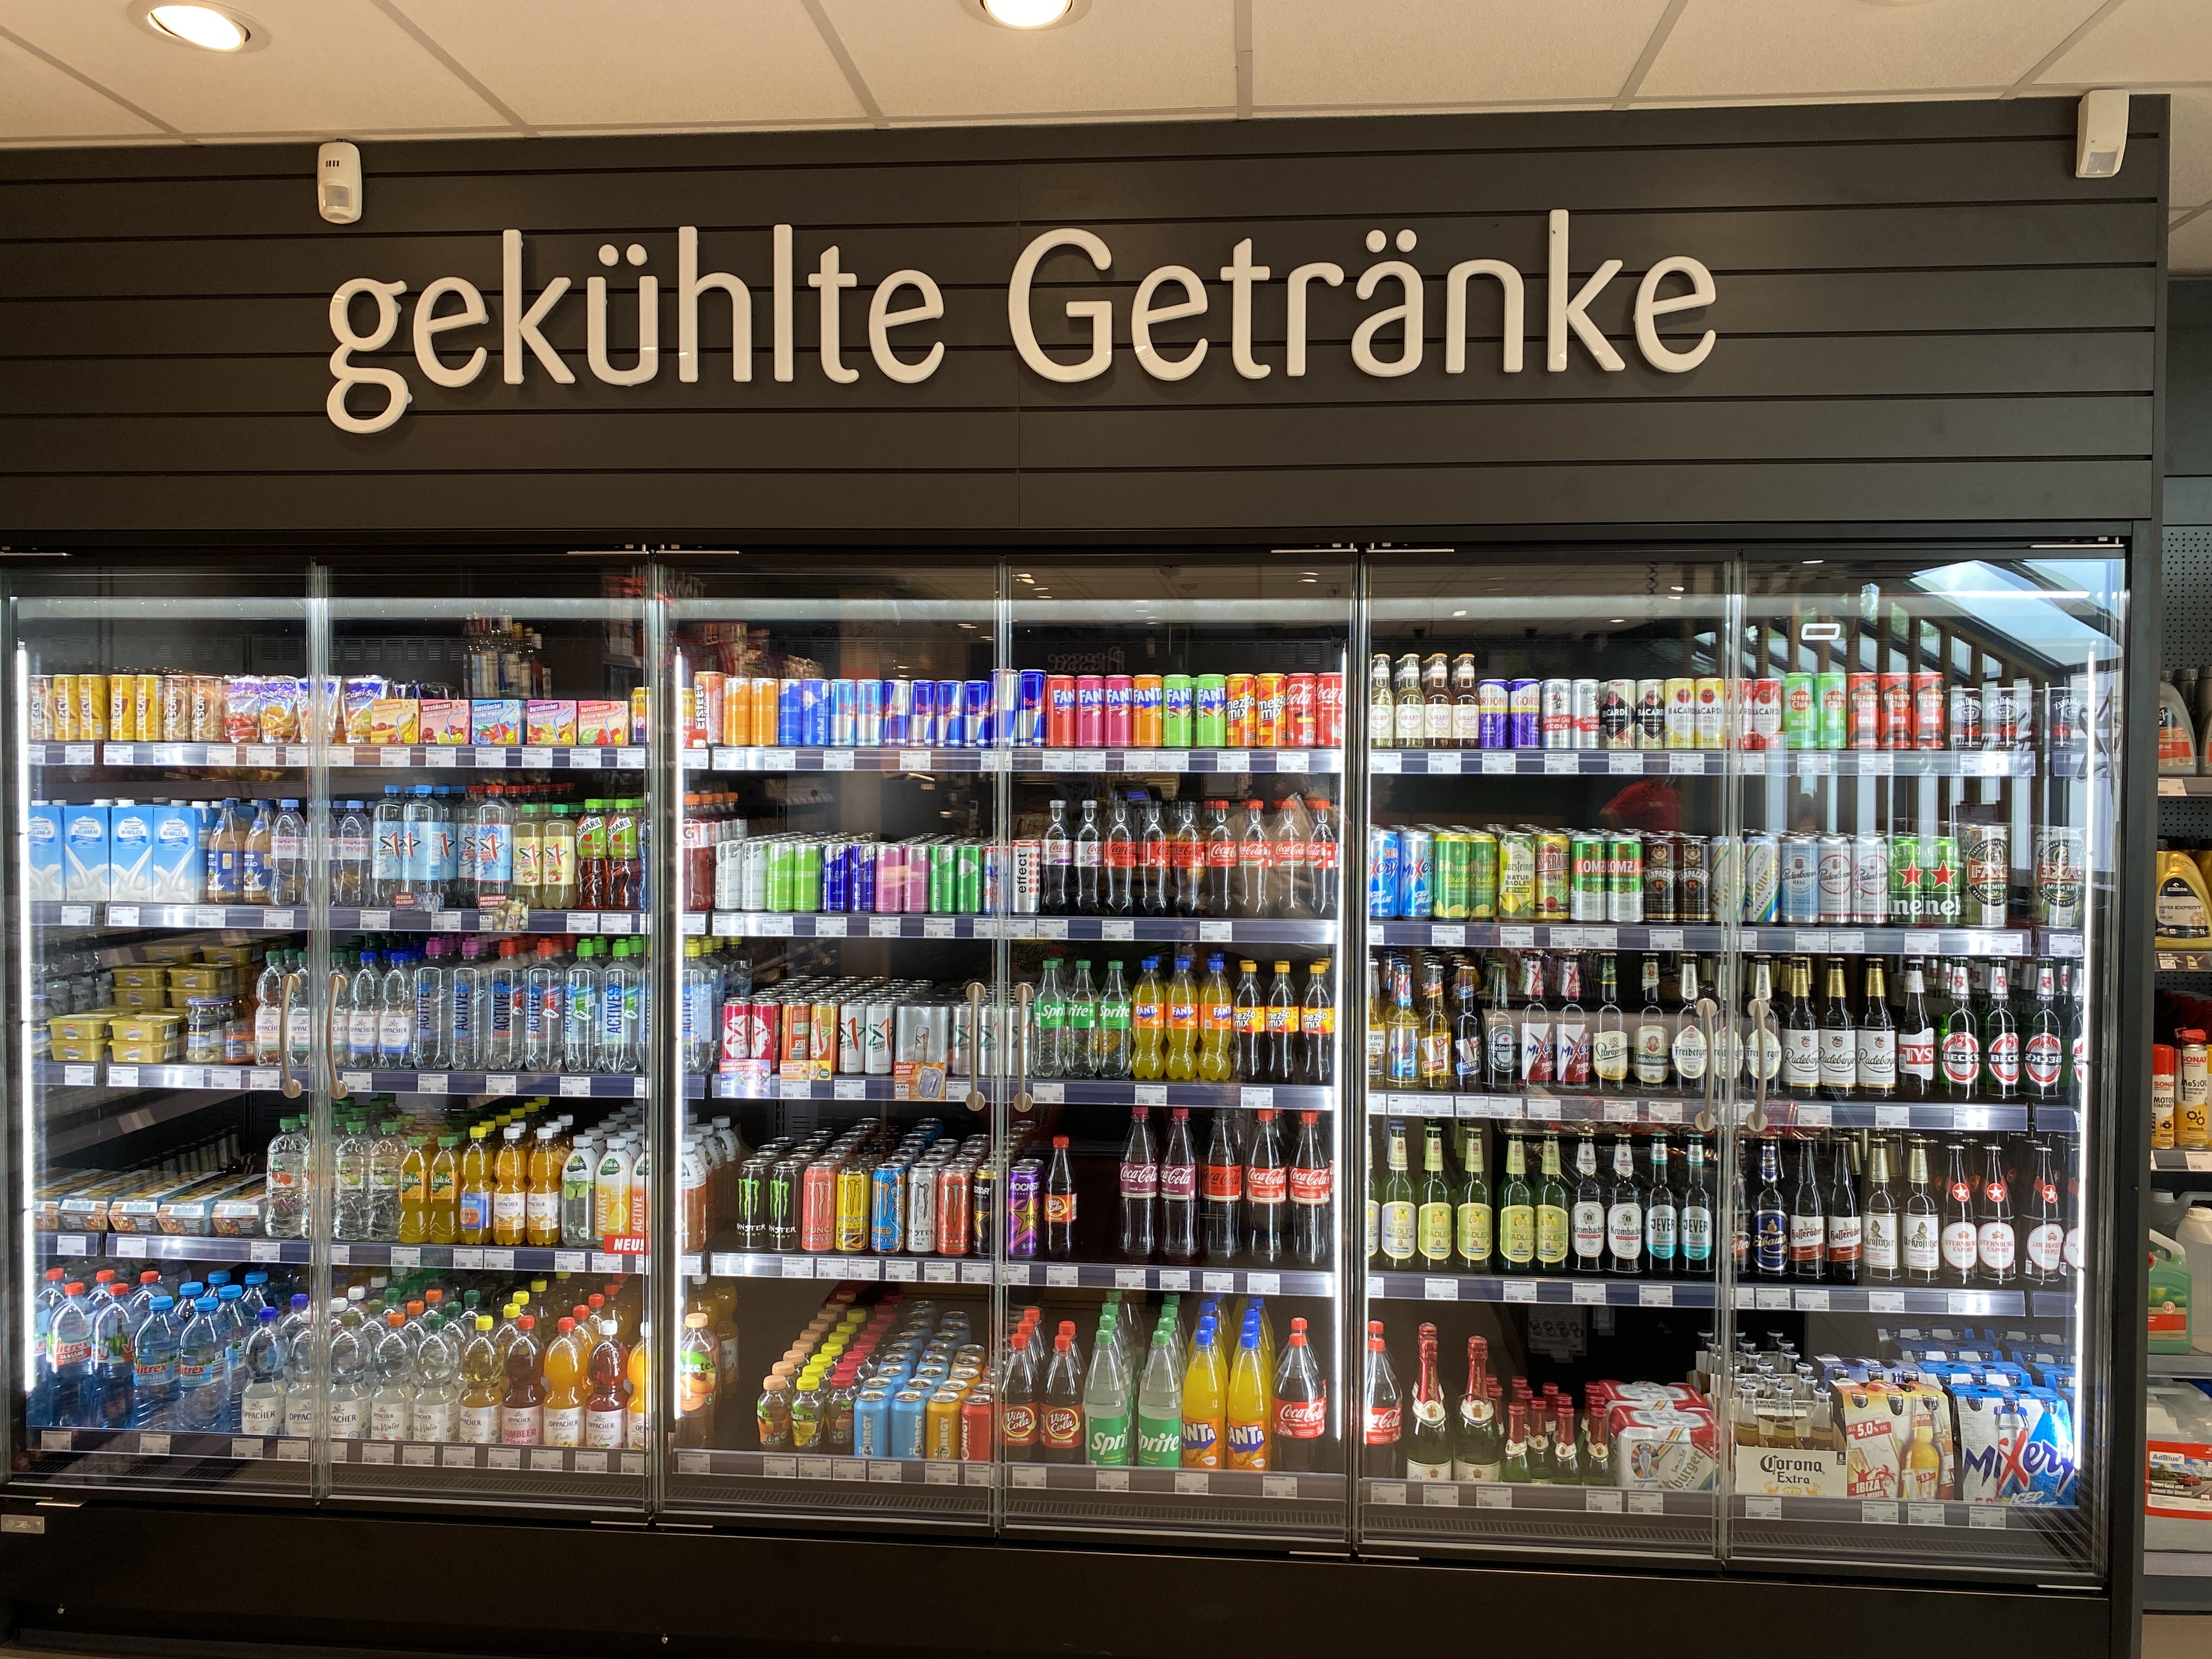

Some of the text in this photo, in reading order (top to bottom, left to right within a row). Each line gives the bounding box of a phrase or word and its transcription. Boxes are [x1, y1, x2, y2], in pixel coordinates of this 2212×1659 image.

[327, 209, 1717, 433] gekühlte Getränke
[1883, 692, 1910, 701] Havana
[1917, 692, 1944, 701] Havana
[422, 703, 450, 712] Durstlöscher
[474, 703, 502, 712] Durstlöscher
[529, 703, 558, 713] Durstlöscher
[580, 703, 611, 713] Durstlöscher
[1792, 700, 1809, 708] Club
[1858, 700, 1873, 708] Club
[1890, 700, 1906, 709] Club
[1923, 700, 1939, 708] Club
[1889, 716, 1906, 725] COLA
[1923, 716, 1939, 724] COLA
[1502, 860, 1534, 873] Warsteiner
[1688, 880, 1697, 889] 9%
[494, 994, 509, 1031] ACTIVE
[606, 994, 622, 1033] ACTIVE
[1099, 1004, 1130, 1025] Sprite
[1135, 1005, 1158, 1017] FANTA
[1171, 1006, 1194, 1018] FANTA
[1266, 1009, 1291, 1023] mezzo
[1302, 1011, 1328, 1024] mezzo
[381, 1026, 407, 1034] OPPACHER
[1942, 1053, 1979, 1063] BECK'S
[1424, 1060, 1443, 1069] CURUBA
[567, 1158, 586, 1167] Volvic
[601, 1159, 620, 1169] Volvic
[1120, 1165, 1158, 1185] Coca-Cola
[1248, 1167, 1285, 1187] Coca-Cola
[1290, 1167, 1329, 1188] Coca-Cola
[126, 1201, 151, 1211] Hofladen
[173, 1204, 198, 1215] Hofladen
[228, 1204, 252, 1215] Hofladen
[596, 1193, 607, 1231] AWAKE
[634, 1196, 643, 1233] ACTIVE
[805, 1225, 834, 1234] PUNCH
[1385, 1226, 1414, 1235] RADLER
[1650, 1218, 1675, 1233] JEVER
[1683, 1218, 1708, 1233] JEVER
[1424, 1229, 1451, 1238] RADLER
[1462, 1229, 1488, 1238] RADLER
[1505, 1232, 1534, 1240] RADLER
[613, 1237, 645, 1251] NEU!
[134, 1358, 168, 1373] Vitrex
[242, 1410, 275, 1420] OPPACHER
[1007, 1410, 1026, 1424] Vita
[1280, 1402, 1324, 1422] Coca-Cola
[549, 1419, 579, 1428] OPPACHER
[1049, 1413, 1070, 1424] Vita
[380, 1421, 399, 1432] Water
[420, 1423, 438, 1432] Water
[1007, 1419, 1030, 1431] Cola
[1050, 1420, 1075, 1432] Cola
[504, 1429, 537, 1438] HIMBEER
[1760, 1454, 1825, 1475] Corona
[1777, 1471, 1810, 1485] Extra
[1855, 1479, 1881, 1491] IBIZA
[2010, 1491, 2045, 1504] ICED
